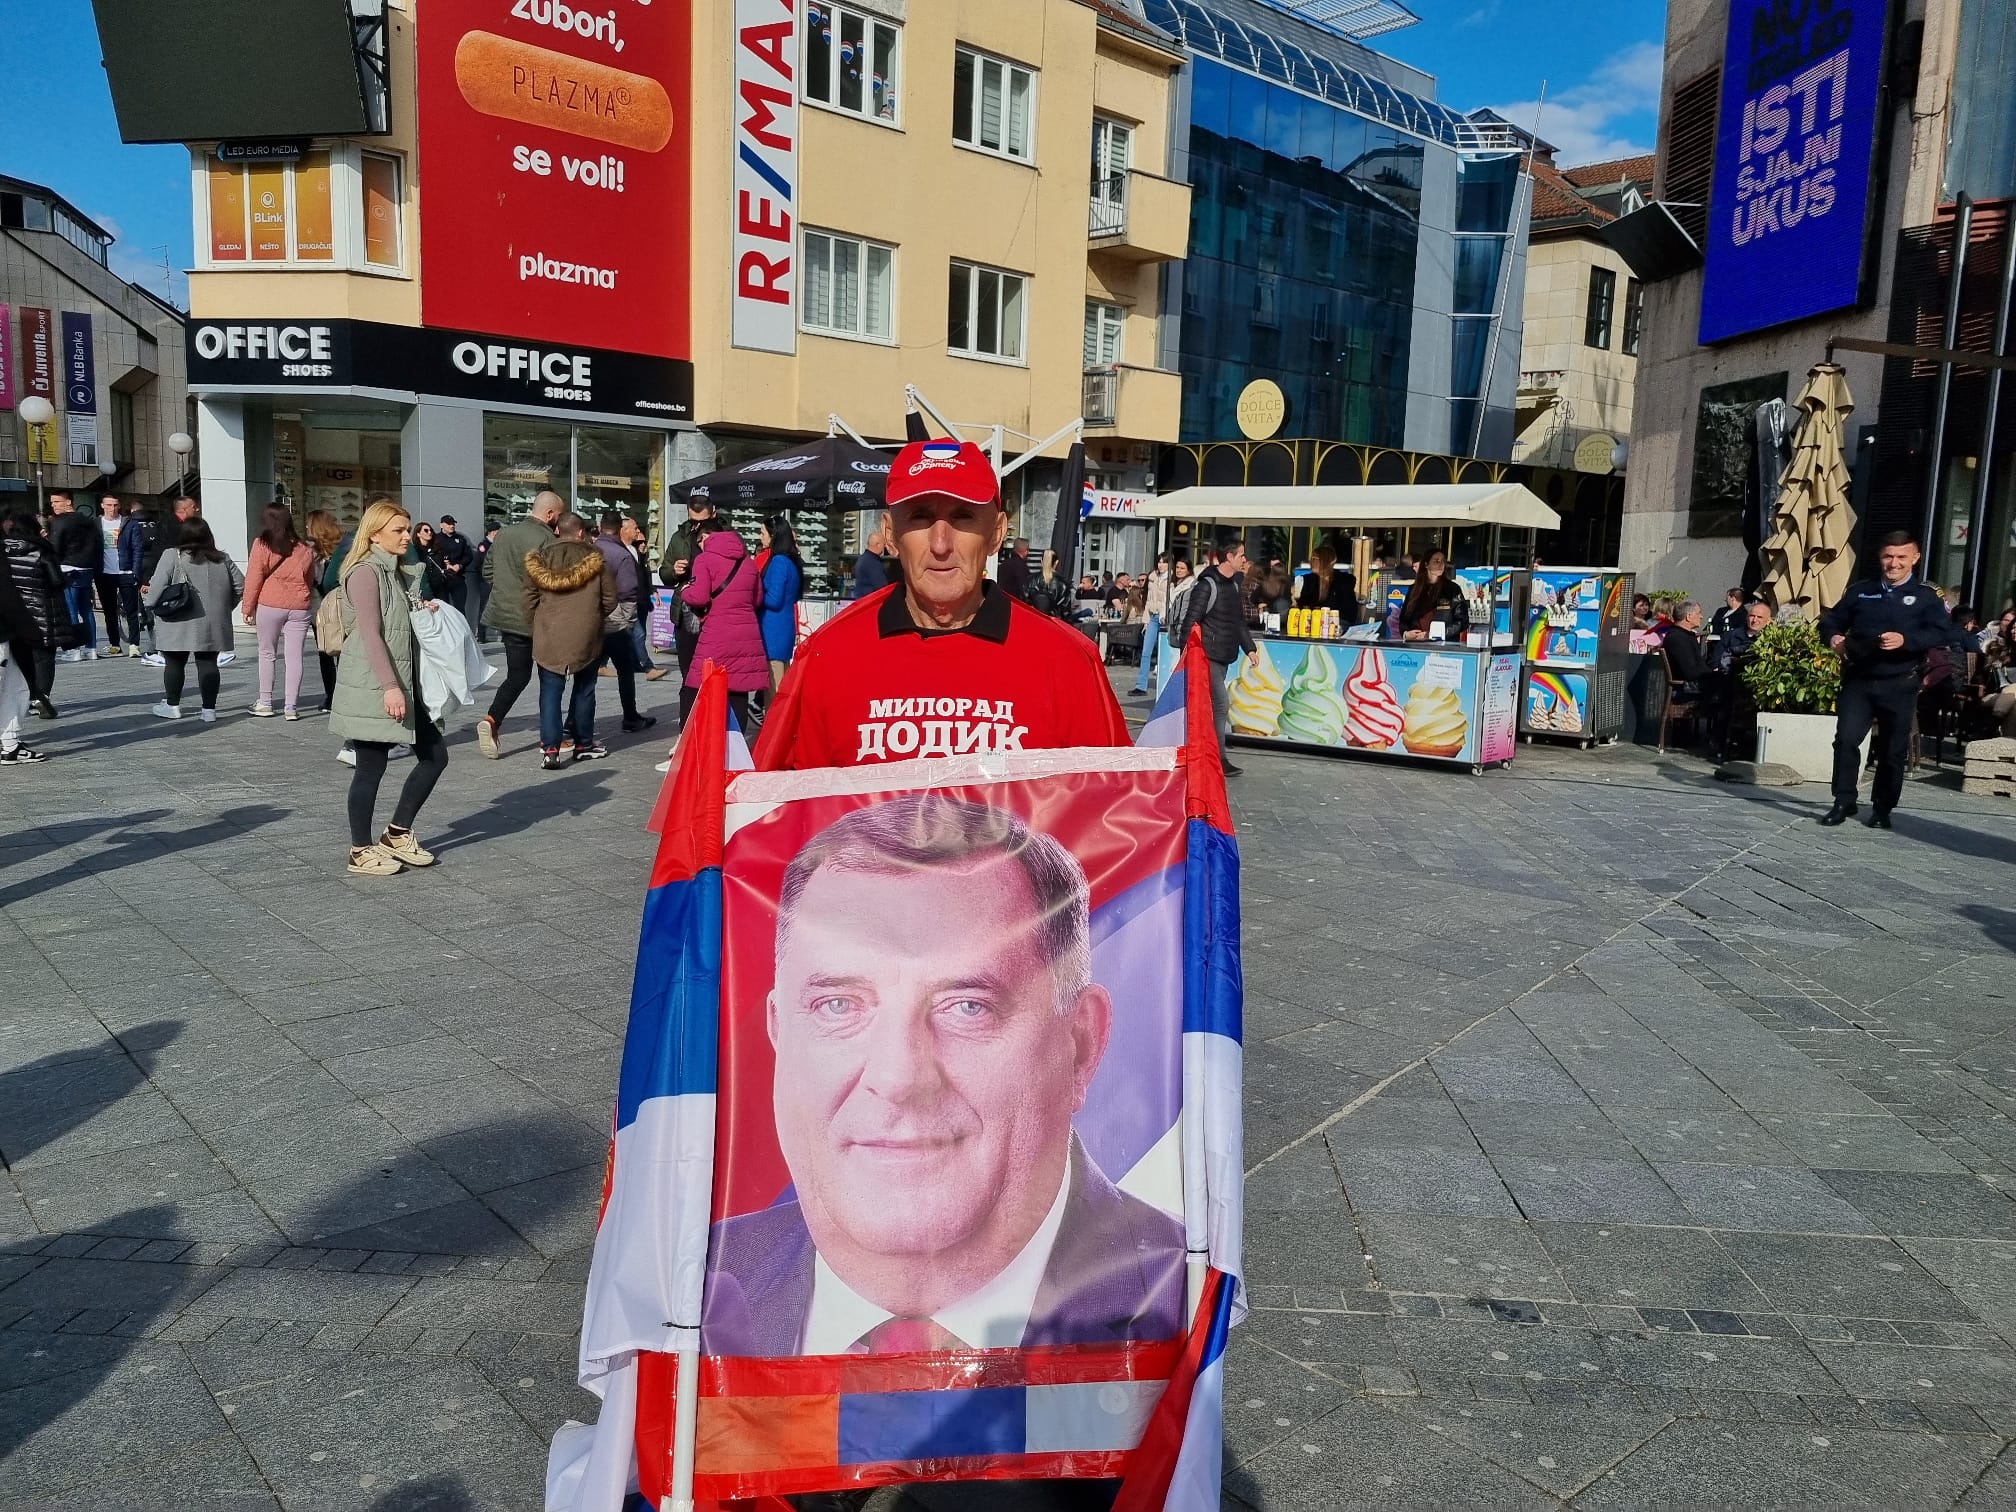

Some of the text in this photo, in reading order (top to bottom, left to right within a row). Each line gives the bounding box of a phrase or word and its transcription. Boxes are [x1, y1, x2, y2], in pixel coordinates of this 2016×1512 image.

[1738, 48, 1850, 164] ISTI
[226, 144, 299, 157] LED EURO MEDIA
[738, 0, 794, 305] RE/MA
[512, 145, 625, 193] se voli!
[254, 212, 283, 223] BLink
[1732, 167, 1837, 247] UKUS
[218, 243, 242, 251] GLEDAJ
[259, 241, 280, 251] NEŠTO
[519, 251, 616, 290] plazma
[32, 310, 48, 377] Juventa SPORT
[195, 325, 332, 360] OFFICE
[73, 331, 86, 382] NLB Banka
[452, 341, 592, 386] OFFICE
[282, 364, 332, 377] SHOES
[544, 386, 592, 402] SHOES
[635, 400, 687, 412] officeshoes.ba
[1240, 399, 1281, 413] DOLCE
[1577, 448, 1611, 457] DOLC
[1101, 496, 1146, 513] RE/M
[868, 697, 1014, 723] МИЛОРАД
[856, 720, 1030, 762] ДОДИК
